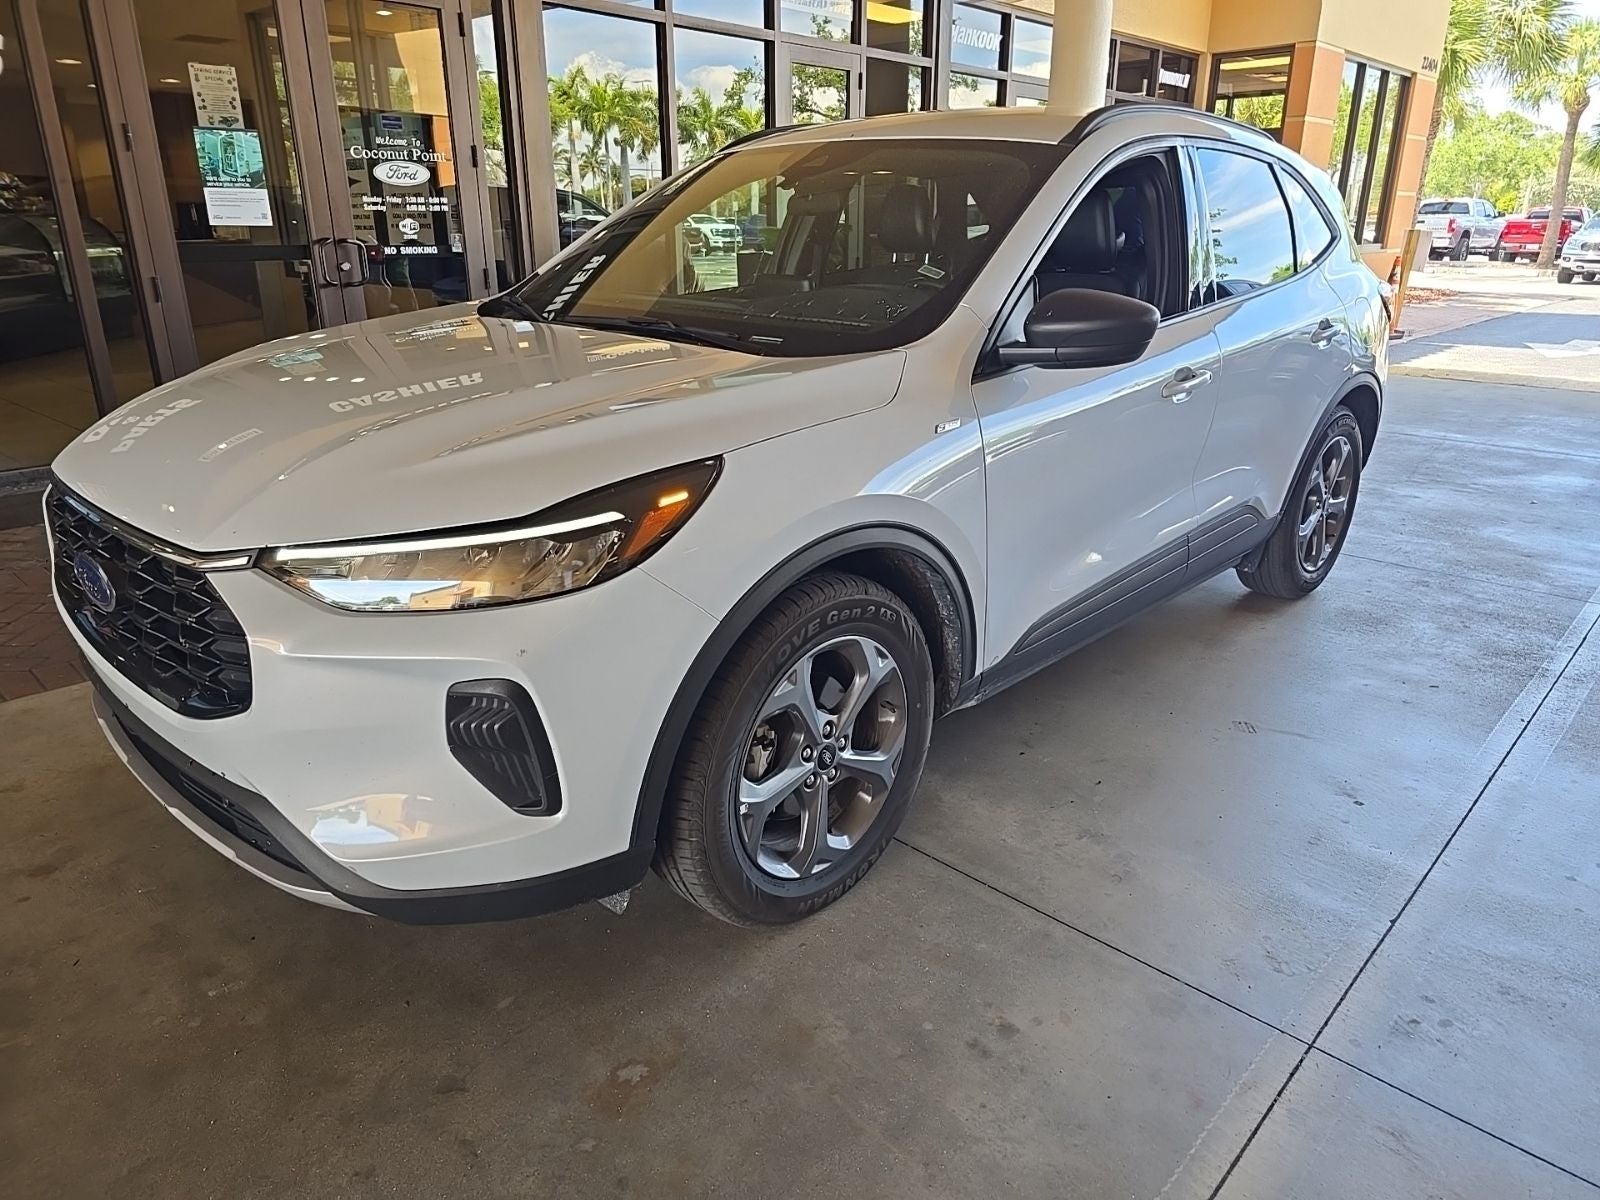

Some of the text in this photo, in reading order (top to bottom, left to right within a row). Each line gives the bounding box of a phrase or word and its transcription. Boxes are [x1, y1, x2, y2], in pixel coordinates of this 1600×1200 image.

[375, 135, 421, 147] Welcome To
[350, 145, 447, 162] Coconut Point
[385, 164, 419, 181] Ford
[363, 195, 382, 204] Monday
[386, 195, 402, 204] Friday
[363, 203, 387, 212] Saturday
[384, 246, 439, 255] NO SMOKING
[827, 608, 862, 626] Gen
[863, 605, 876, 619] 2
